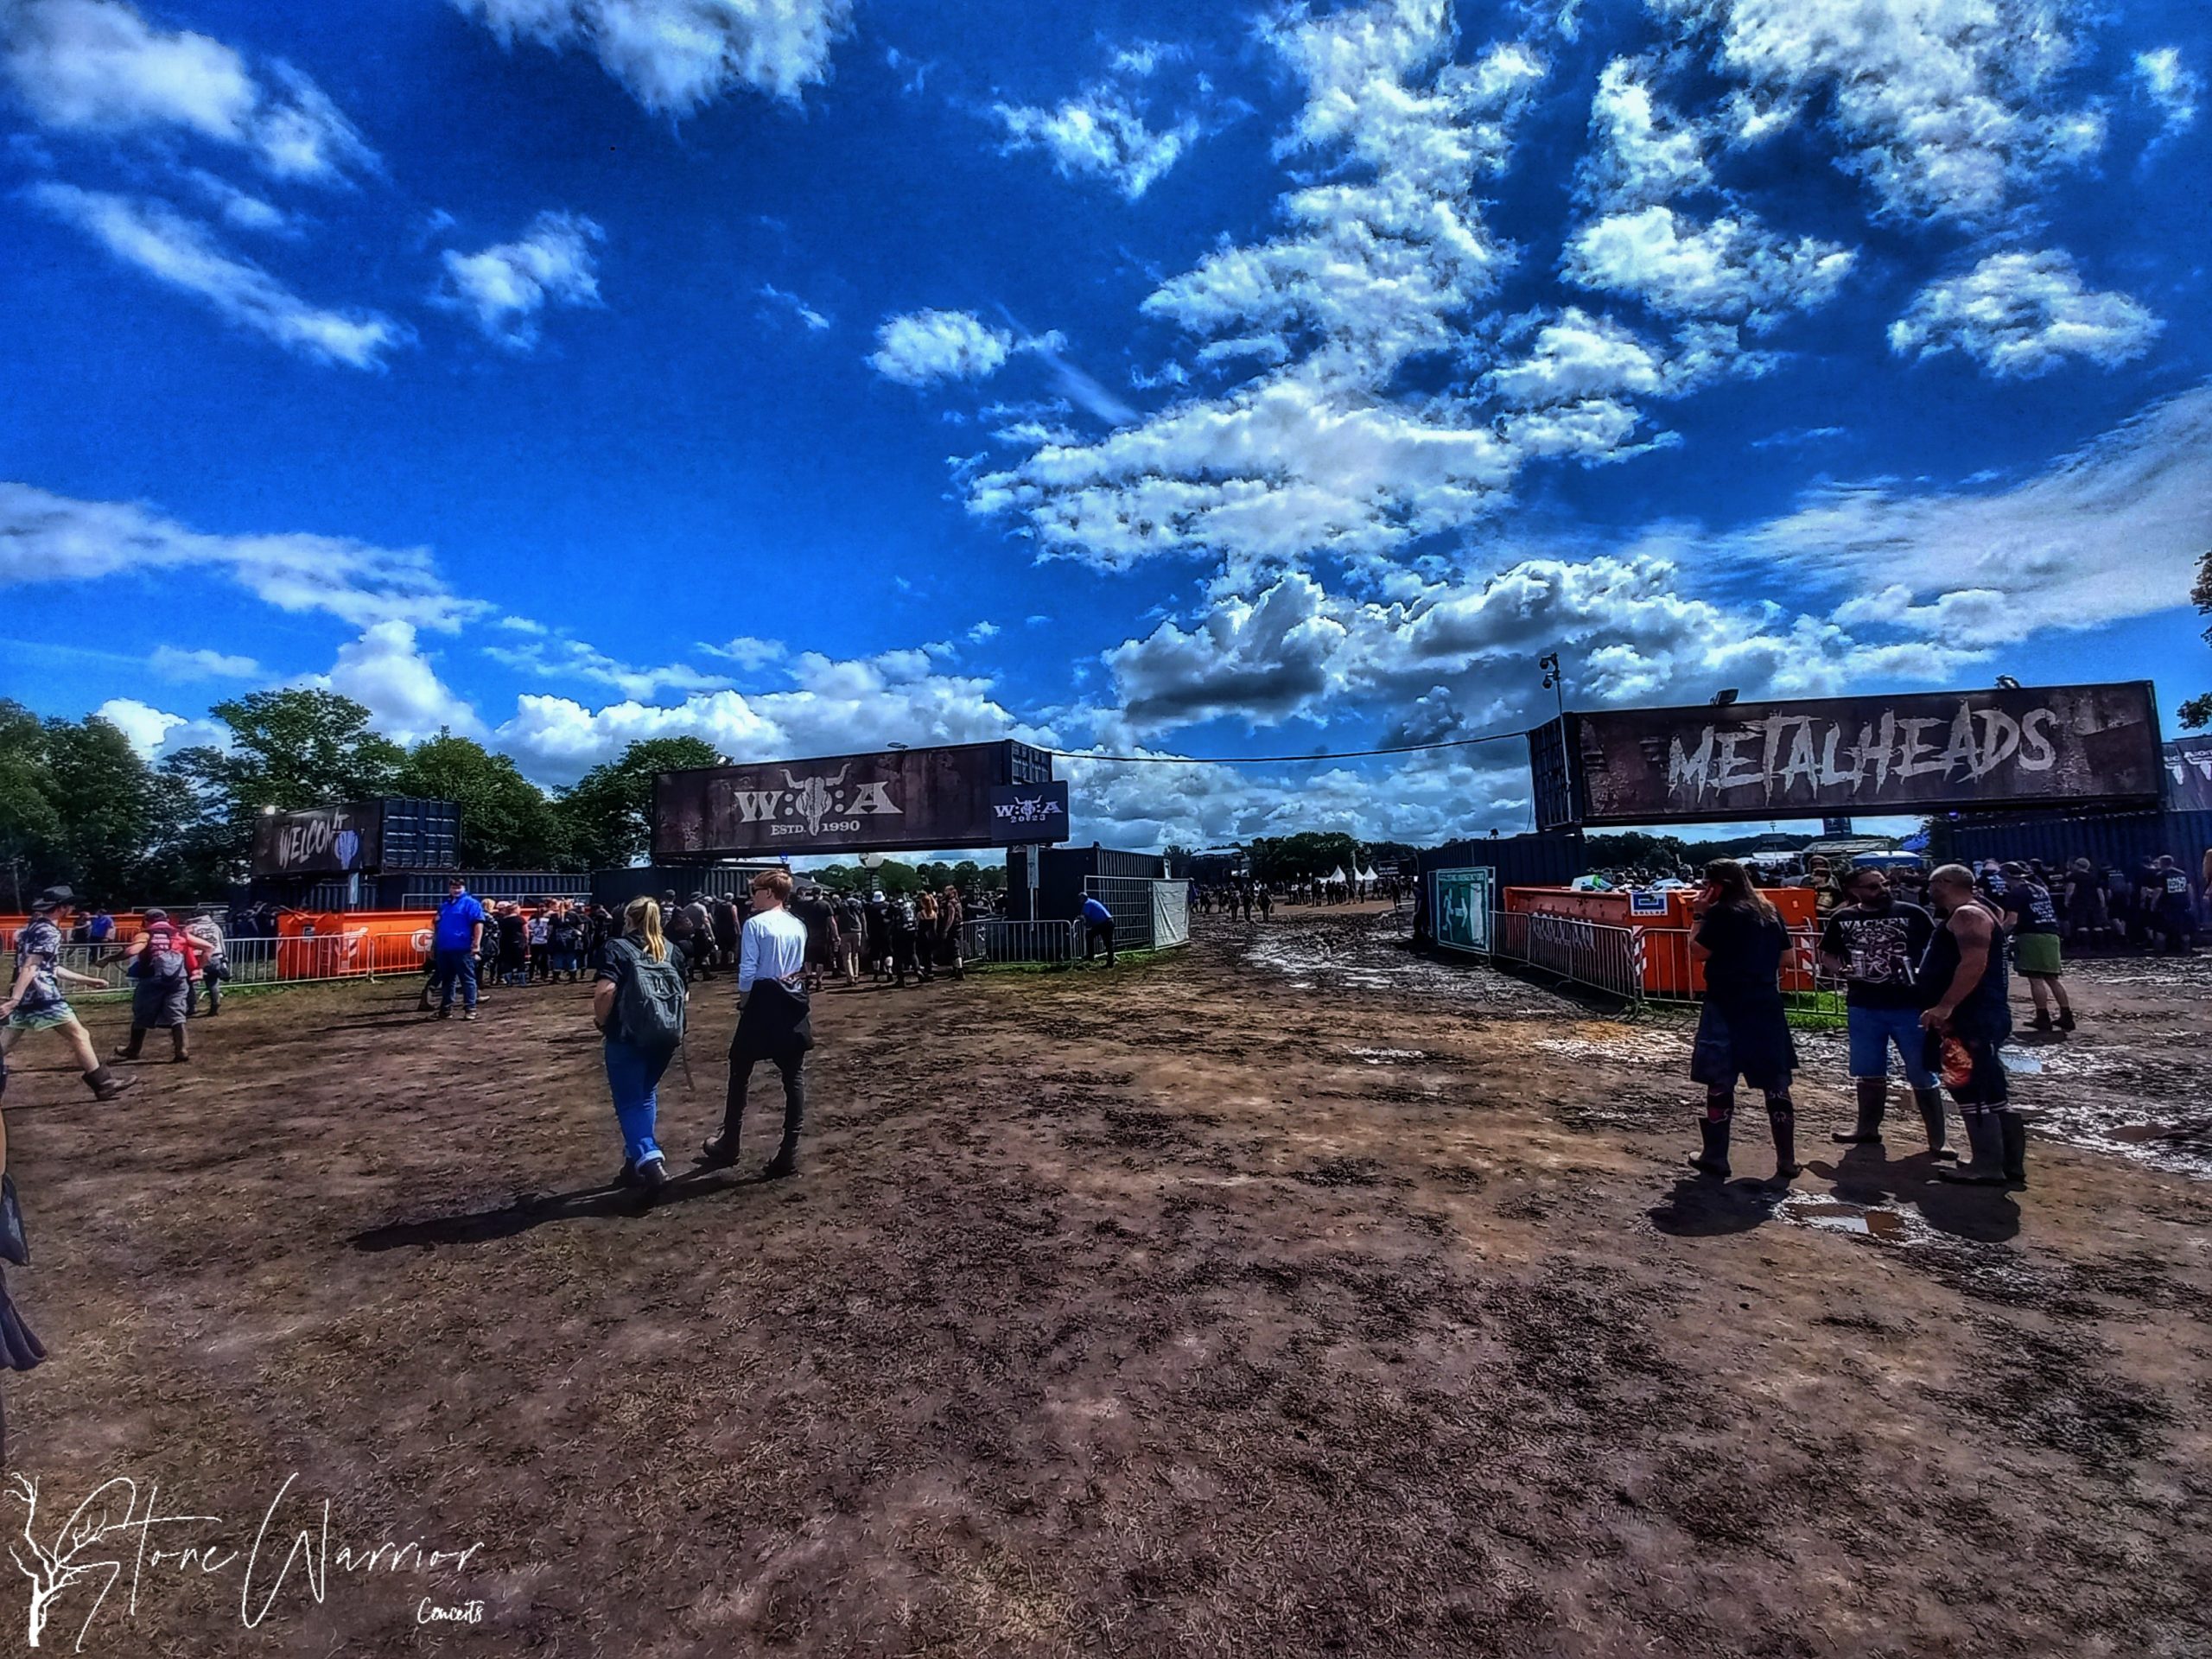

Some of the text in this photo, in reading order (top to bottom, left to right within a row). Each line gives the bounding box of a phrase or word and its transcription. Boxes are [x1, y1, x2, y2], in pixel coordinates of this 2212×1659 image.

[1668, 698, 2058, 806] METALHEADS
[770, 821, 861, 836] ESTD. 1990
[1839, 918, 1910, 930] WACKEN
